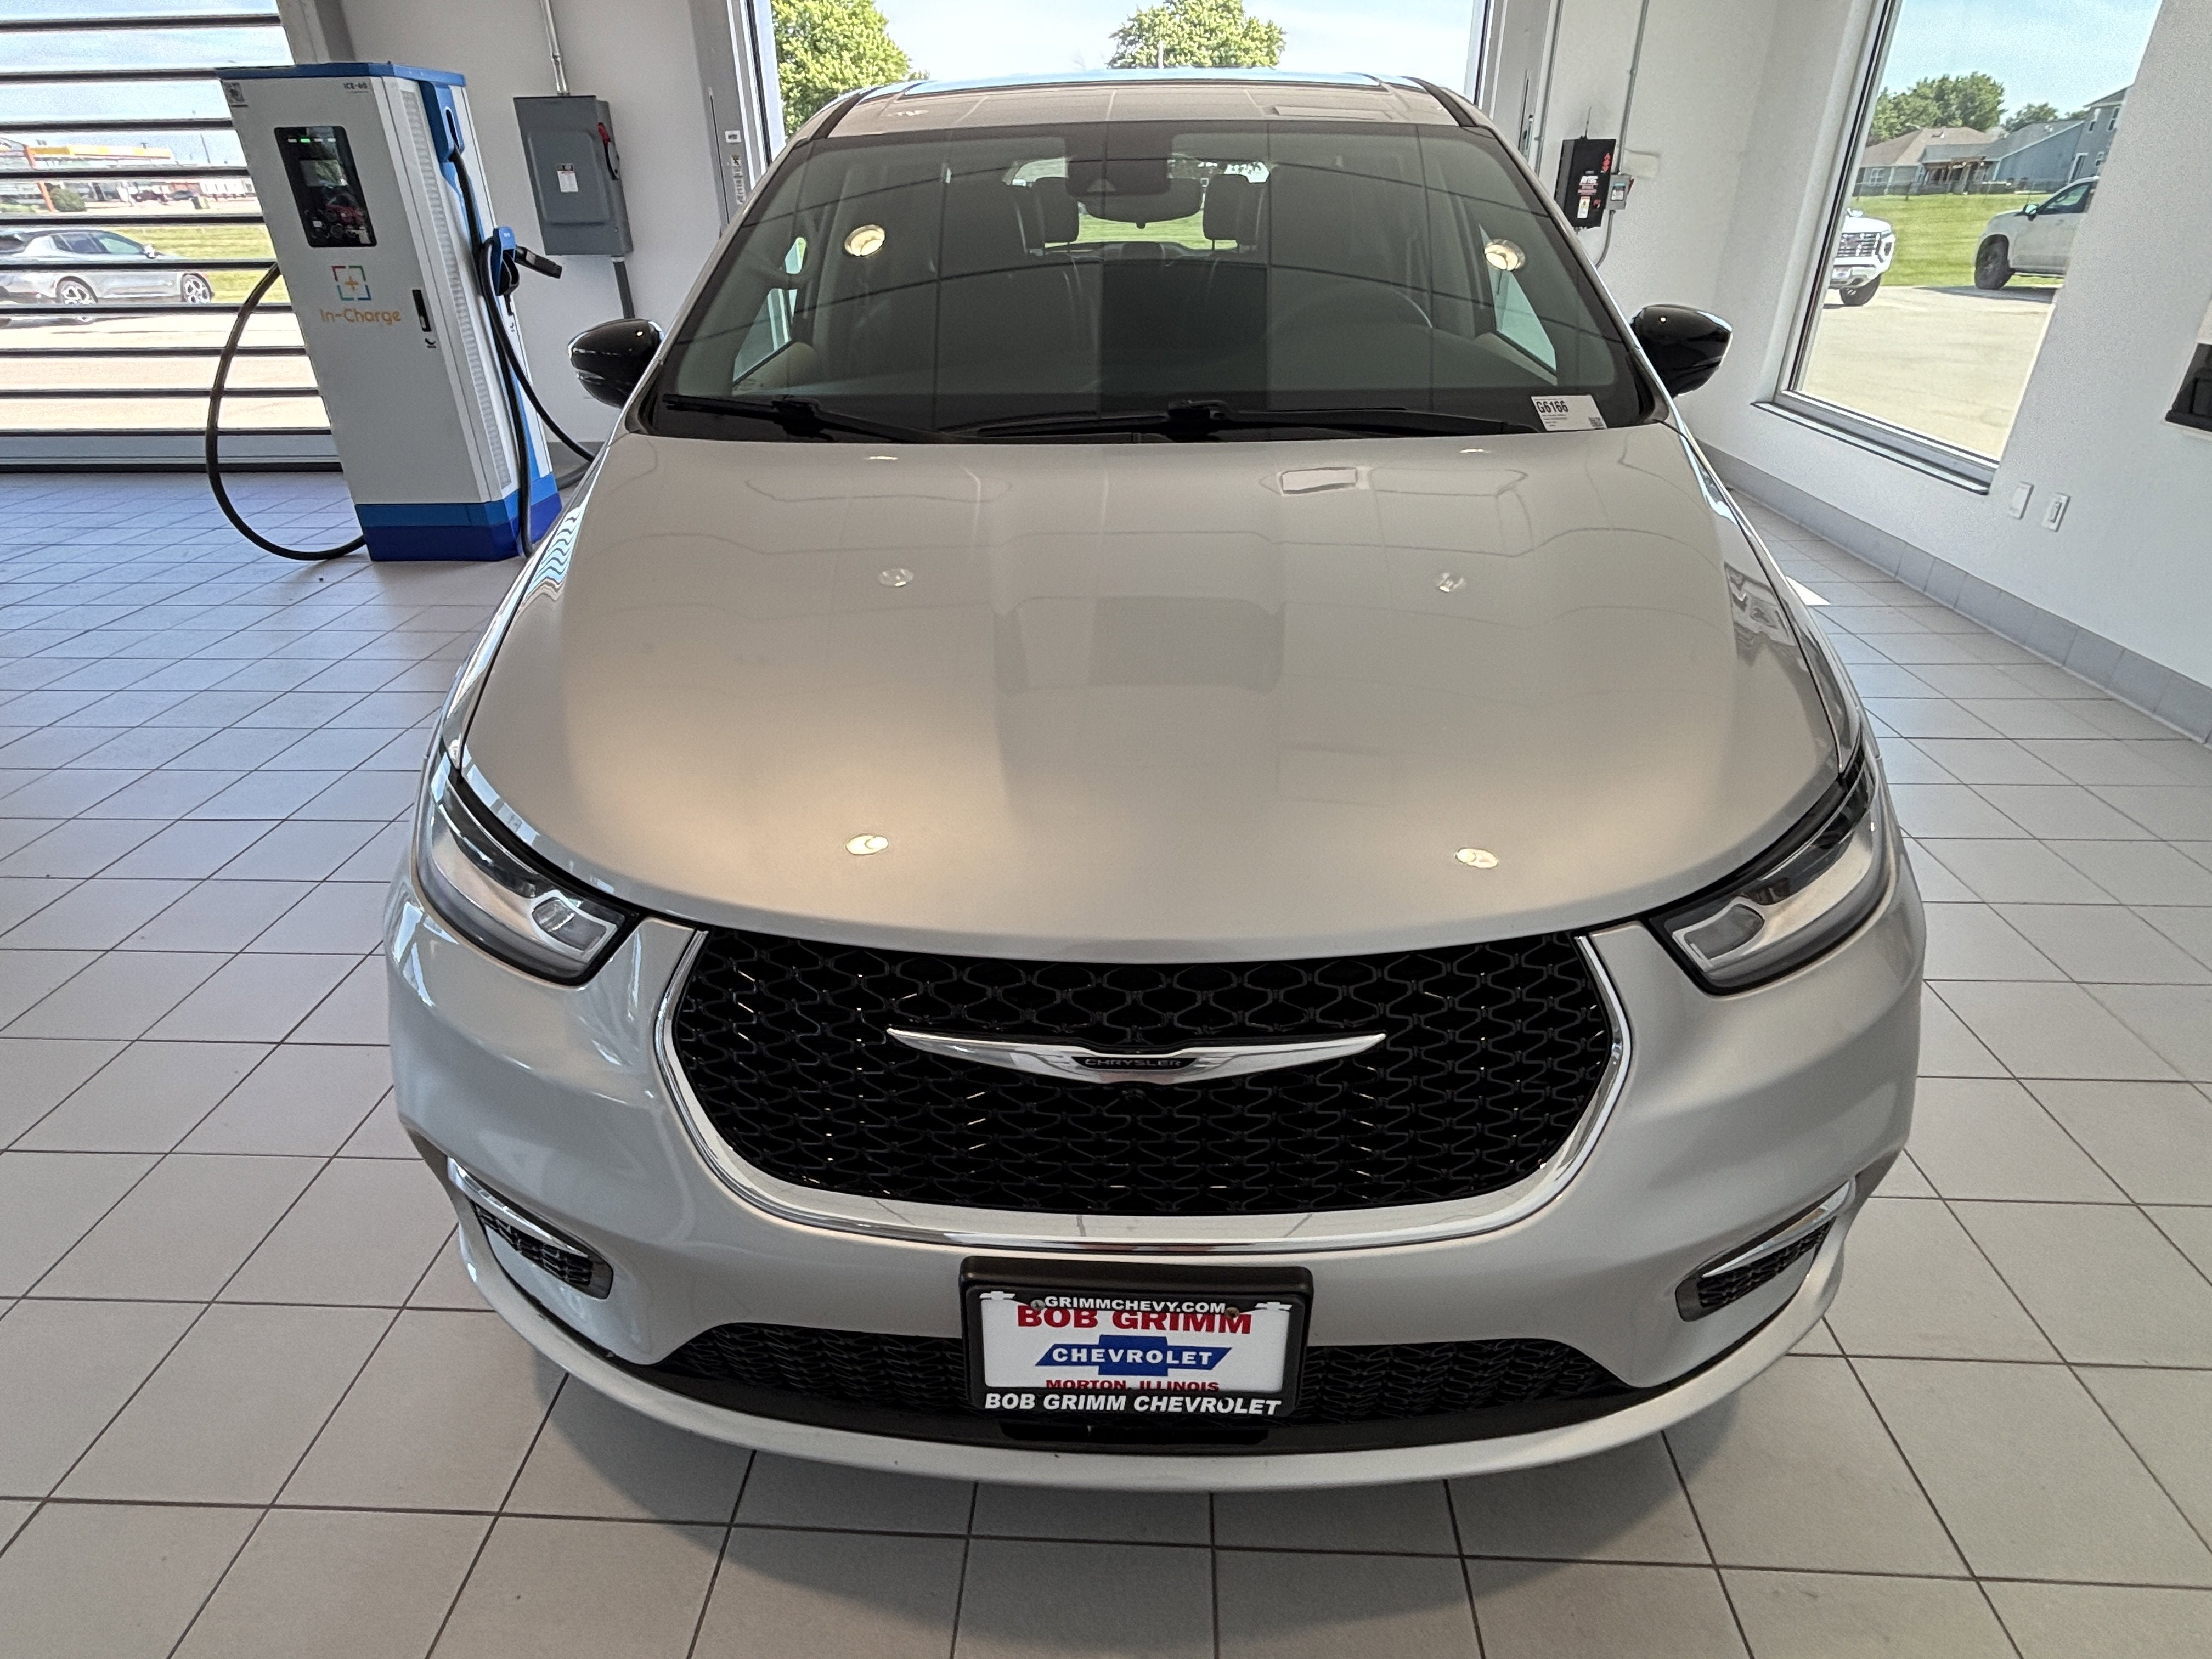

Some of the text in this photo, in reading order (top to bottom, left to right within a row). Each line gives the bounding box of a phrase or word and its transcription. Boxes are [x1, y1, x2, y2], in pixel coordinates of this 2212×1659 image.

[319, 307, 402, 325] In-Charge
[1536, 400, 1569, 413] G6166
[1045, 1296, 1226, 1313] GRIMMCHEVY.COM
[1018, 1305, 1252, 1334] BOB GRIMM
[1052, 1348, 1212, 1365] CHEVROLET
[1139, 1380, 1220, 1391] ILLINOIS
[985, 1393, 1282, 1415] BOB GRIMM CHEVROLET
